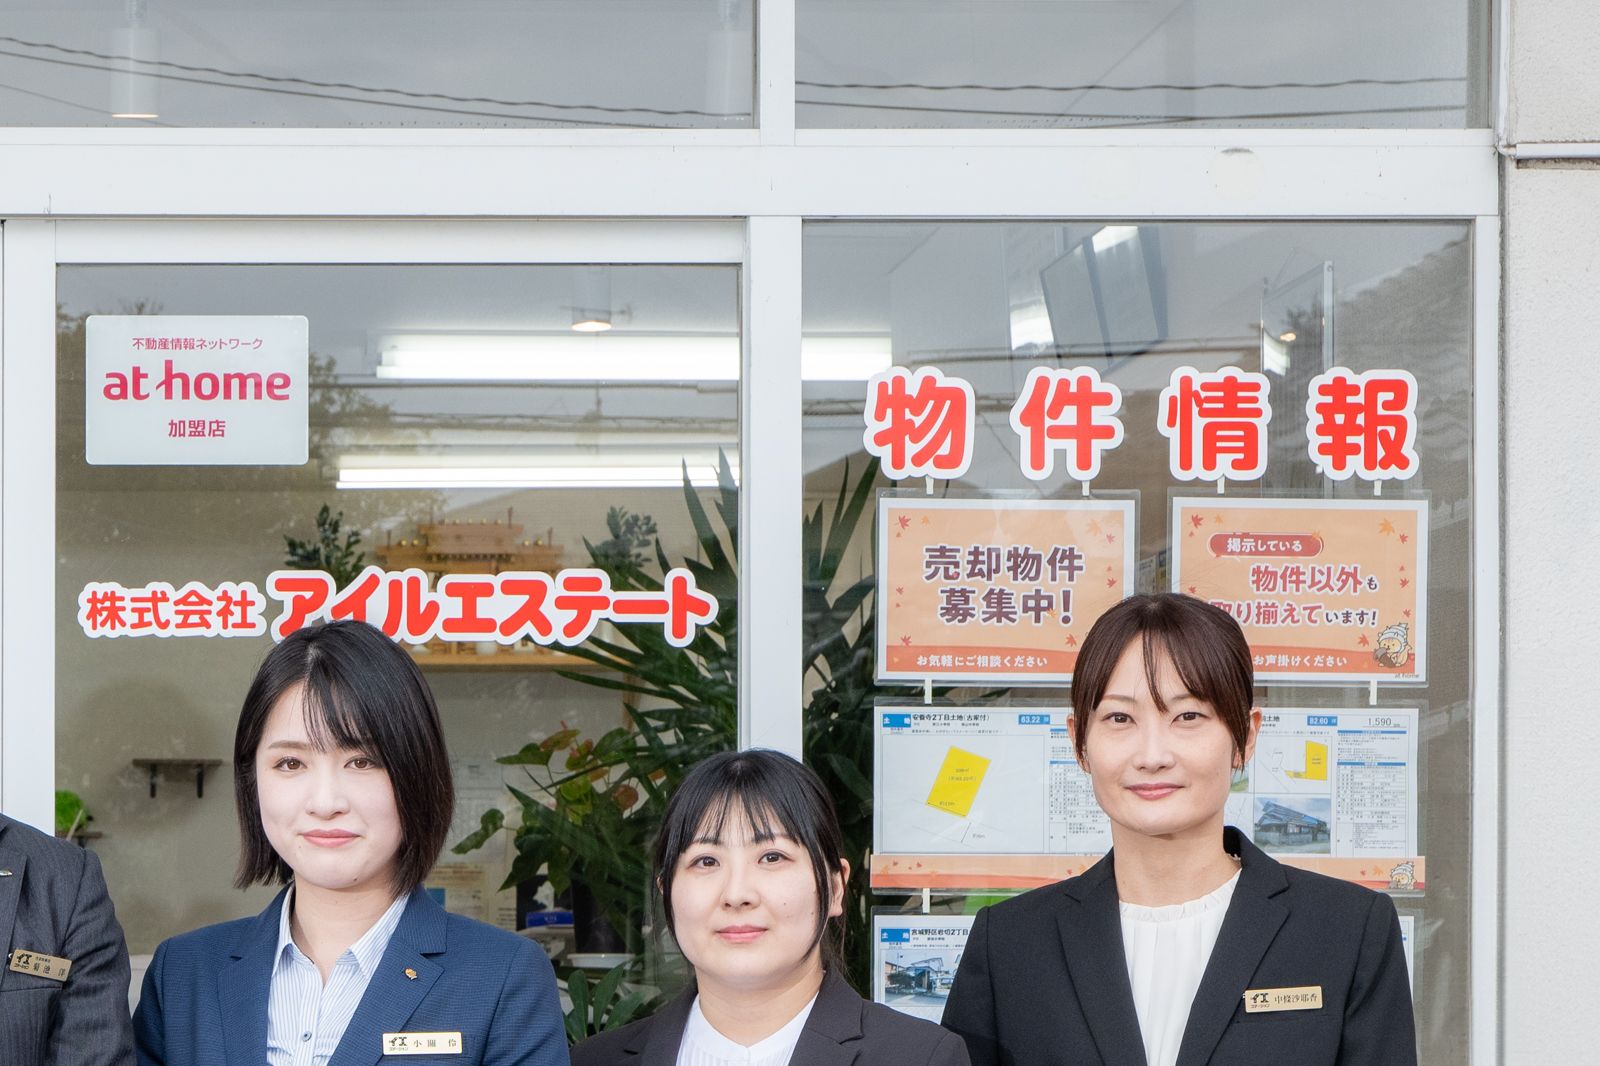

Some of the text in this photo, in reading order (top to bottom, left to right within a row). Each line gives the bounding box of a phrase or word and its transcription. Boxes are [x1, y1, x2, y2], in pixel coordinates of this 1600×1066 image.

[132, 337, 263, 351] 不動産情報ネットワーク
[102, 359, 292, 401] at home
[168, 419, 226, 438] 加盟店
[873, 374, 1411, 472] 物件情報
[1226, 537, 1303, 553] 掲示している
[924, 546, 1084, 582] 売却物件
[1251, 564, 1378, 594] 物件以外も
[86, 572, 711, 640] 株式会社 アイルエステート
[939, 587, 1073, 625] 募集中!
[917, 654, 1048, 668] お気軽にご相談ください
